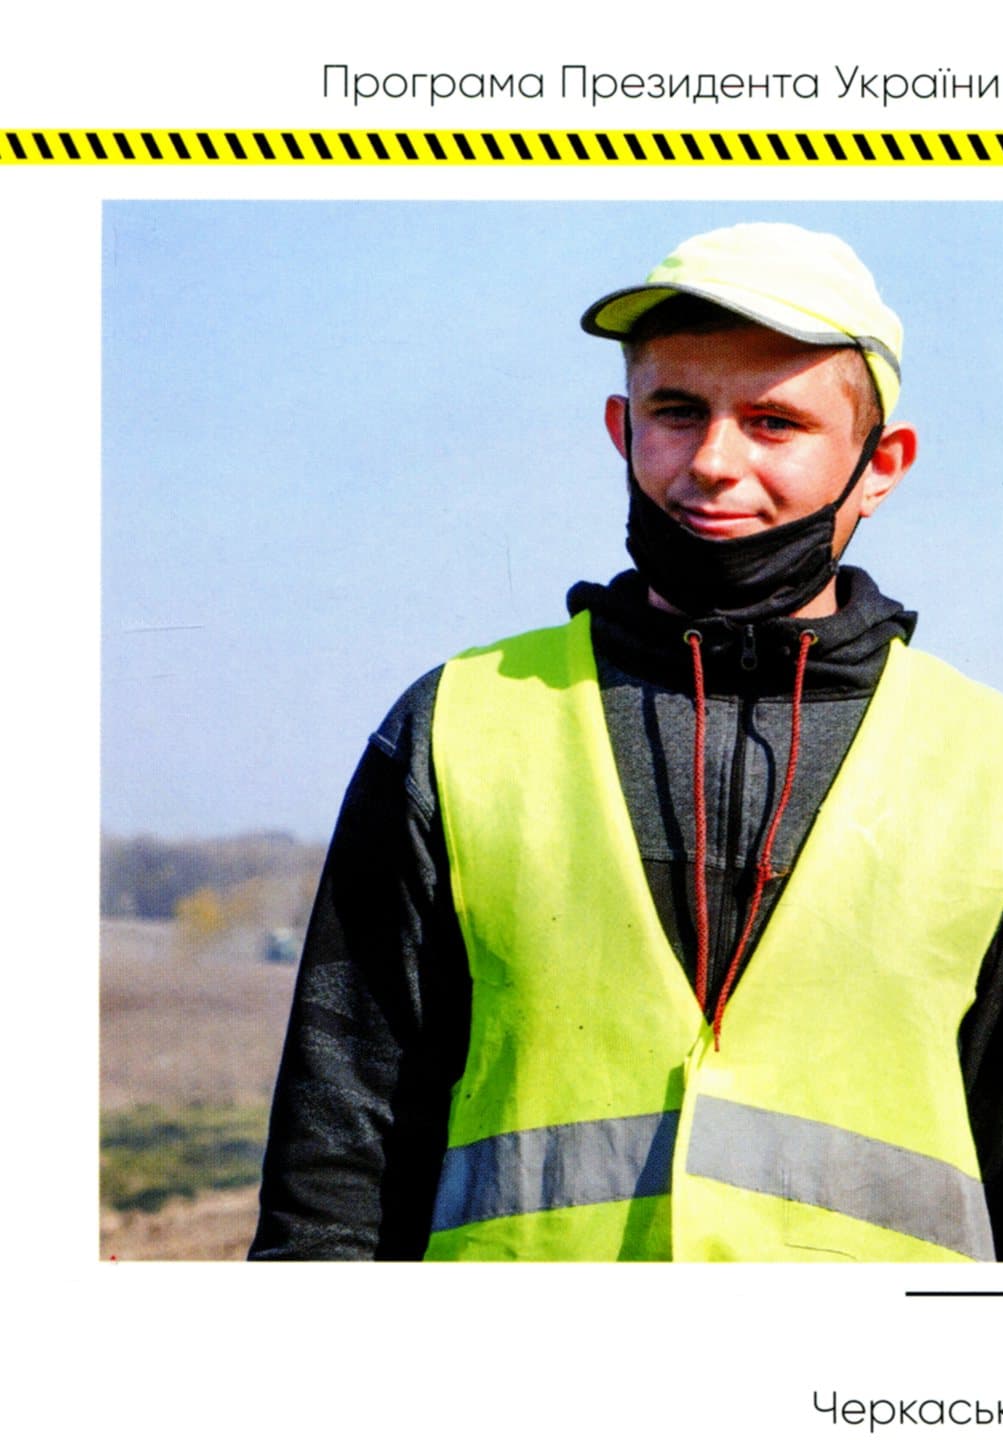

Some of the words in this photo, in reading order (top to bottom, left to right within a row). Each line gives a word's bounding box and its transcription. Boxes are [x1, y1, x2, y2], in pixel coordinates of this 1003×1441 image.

[324, 65, 543, 106] Програма
[562, 65, 818, 106] Президента
[836, 66, 998, 107] України
